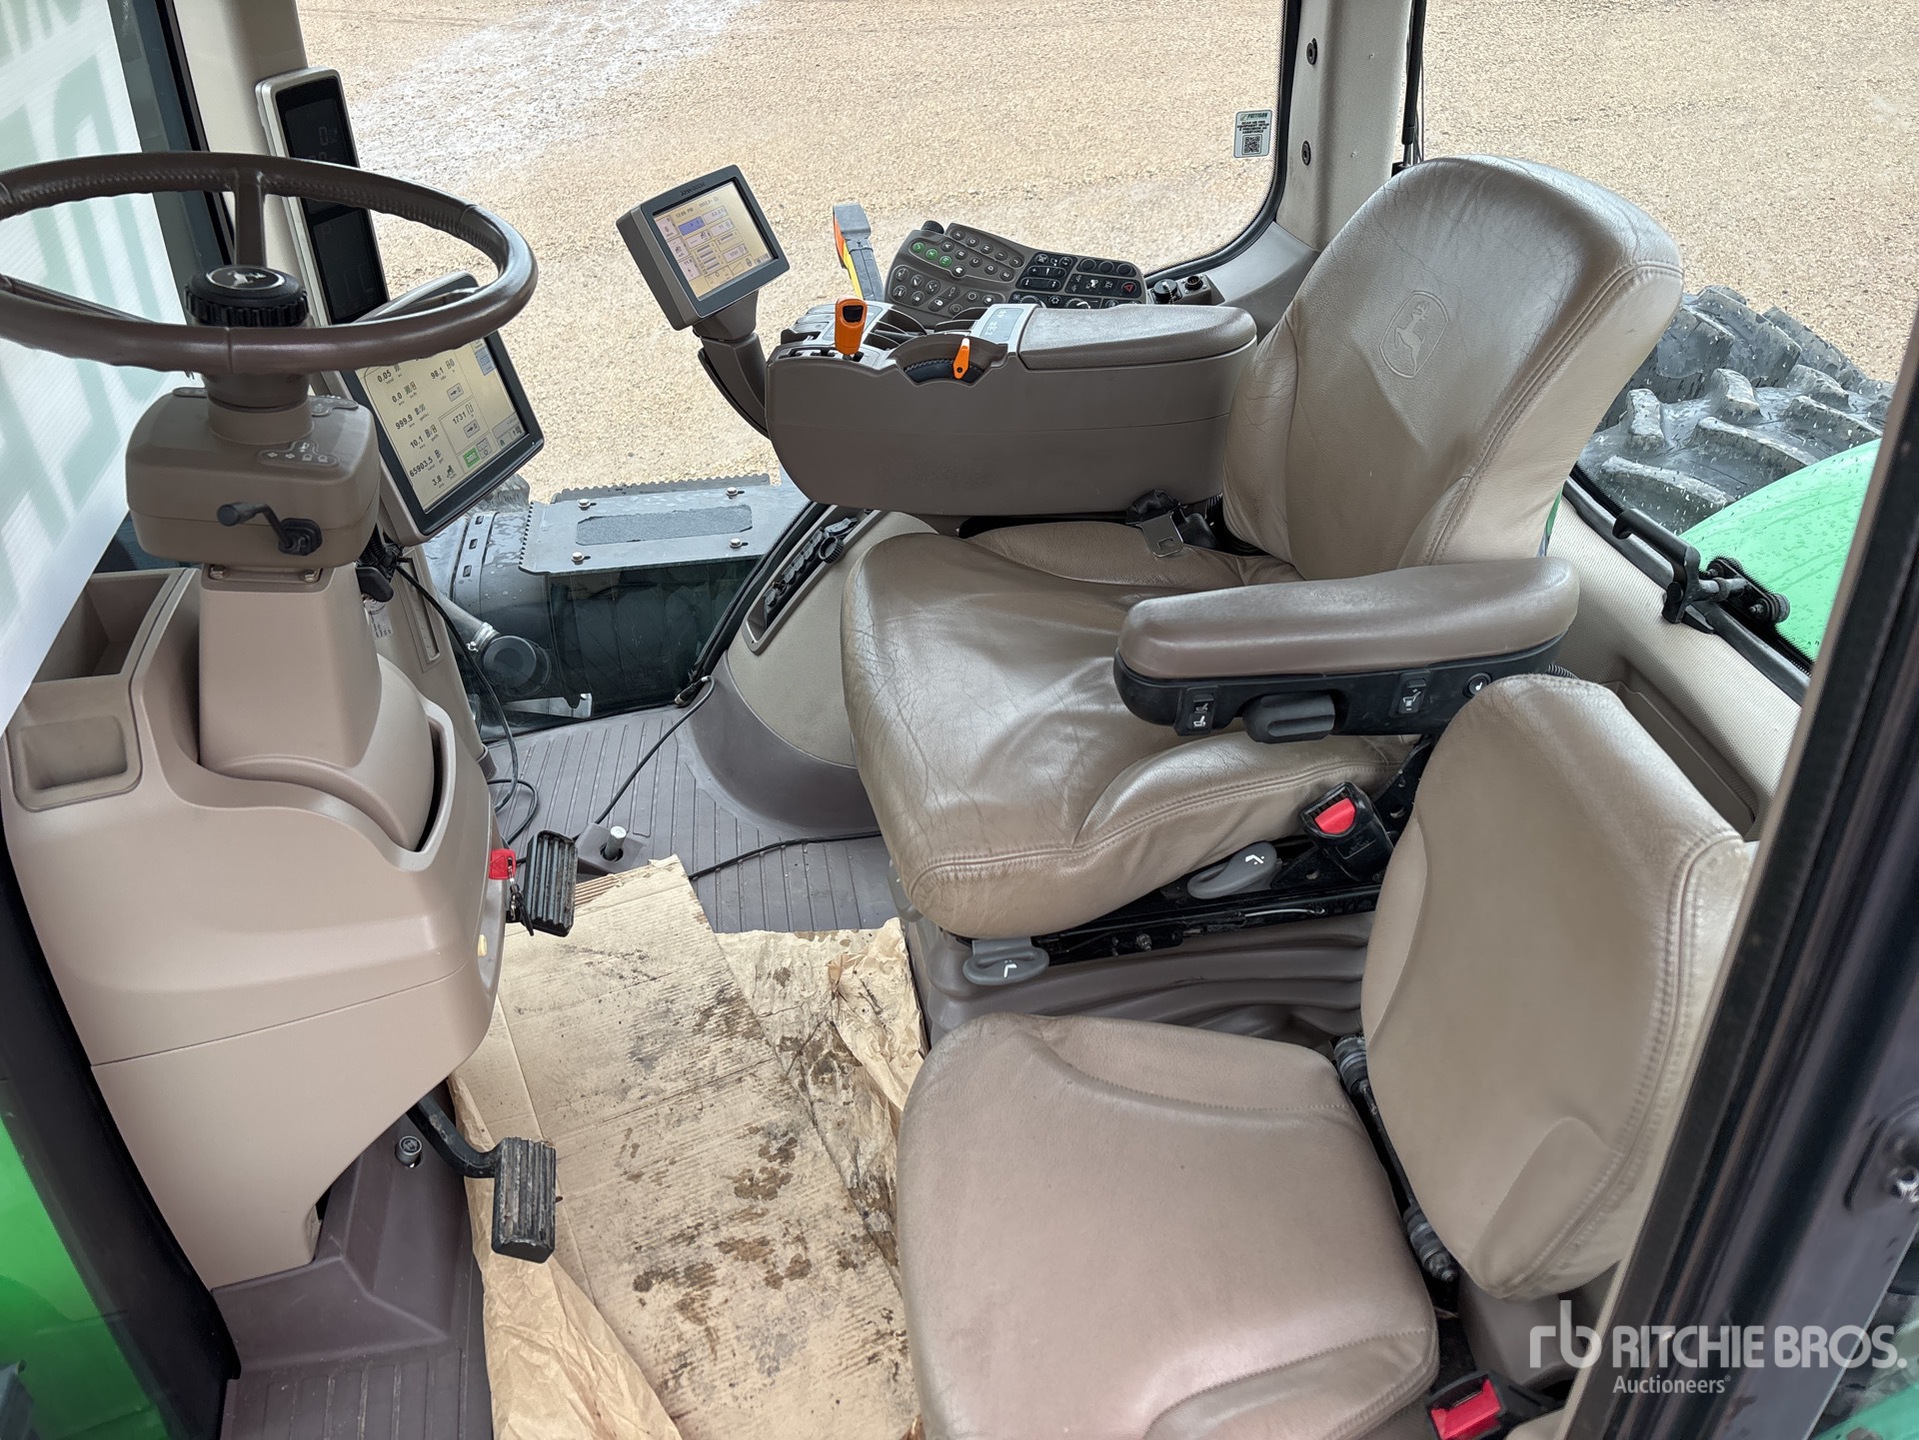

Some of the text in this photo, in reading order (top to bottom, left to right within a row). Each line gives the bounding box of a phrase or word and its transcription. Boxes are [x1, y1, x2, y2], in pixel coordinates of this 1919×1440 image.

[378, 370, 392, 382] 0.05
[430, 368, 444, 379] 98.1
[392, 392, 402, 402] 0.0
[395, 414, 413, 429] 999.9
[452, 412, 467, 424] 1731
[410, 436, 423, 448] 10.1
[409, 456, 433, 477] 65903.5
[432, 475, 442, 486] 3.8
